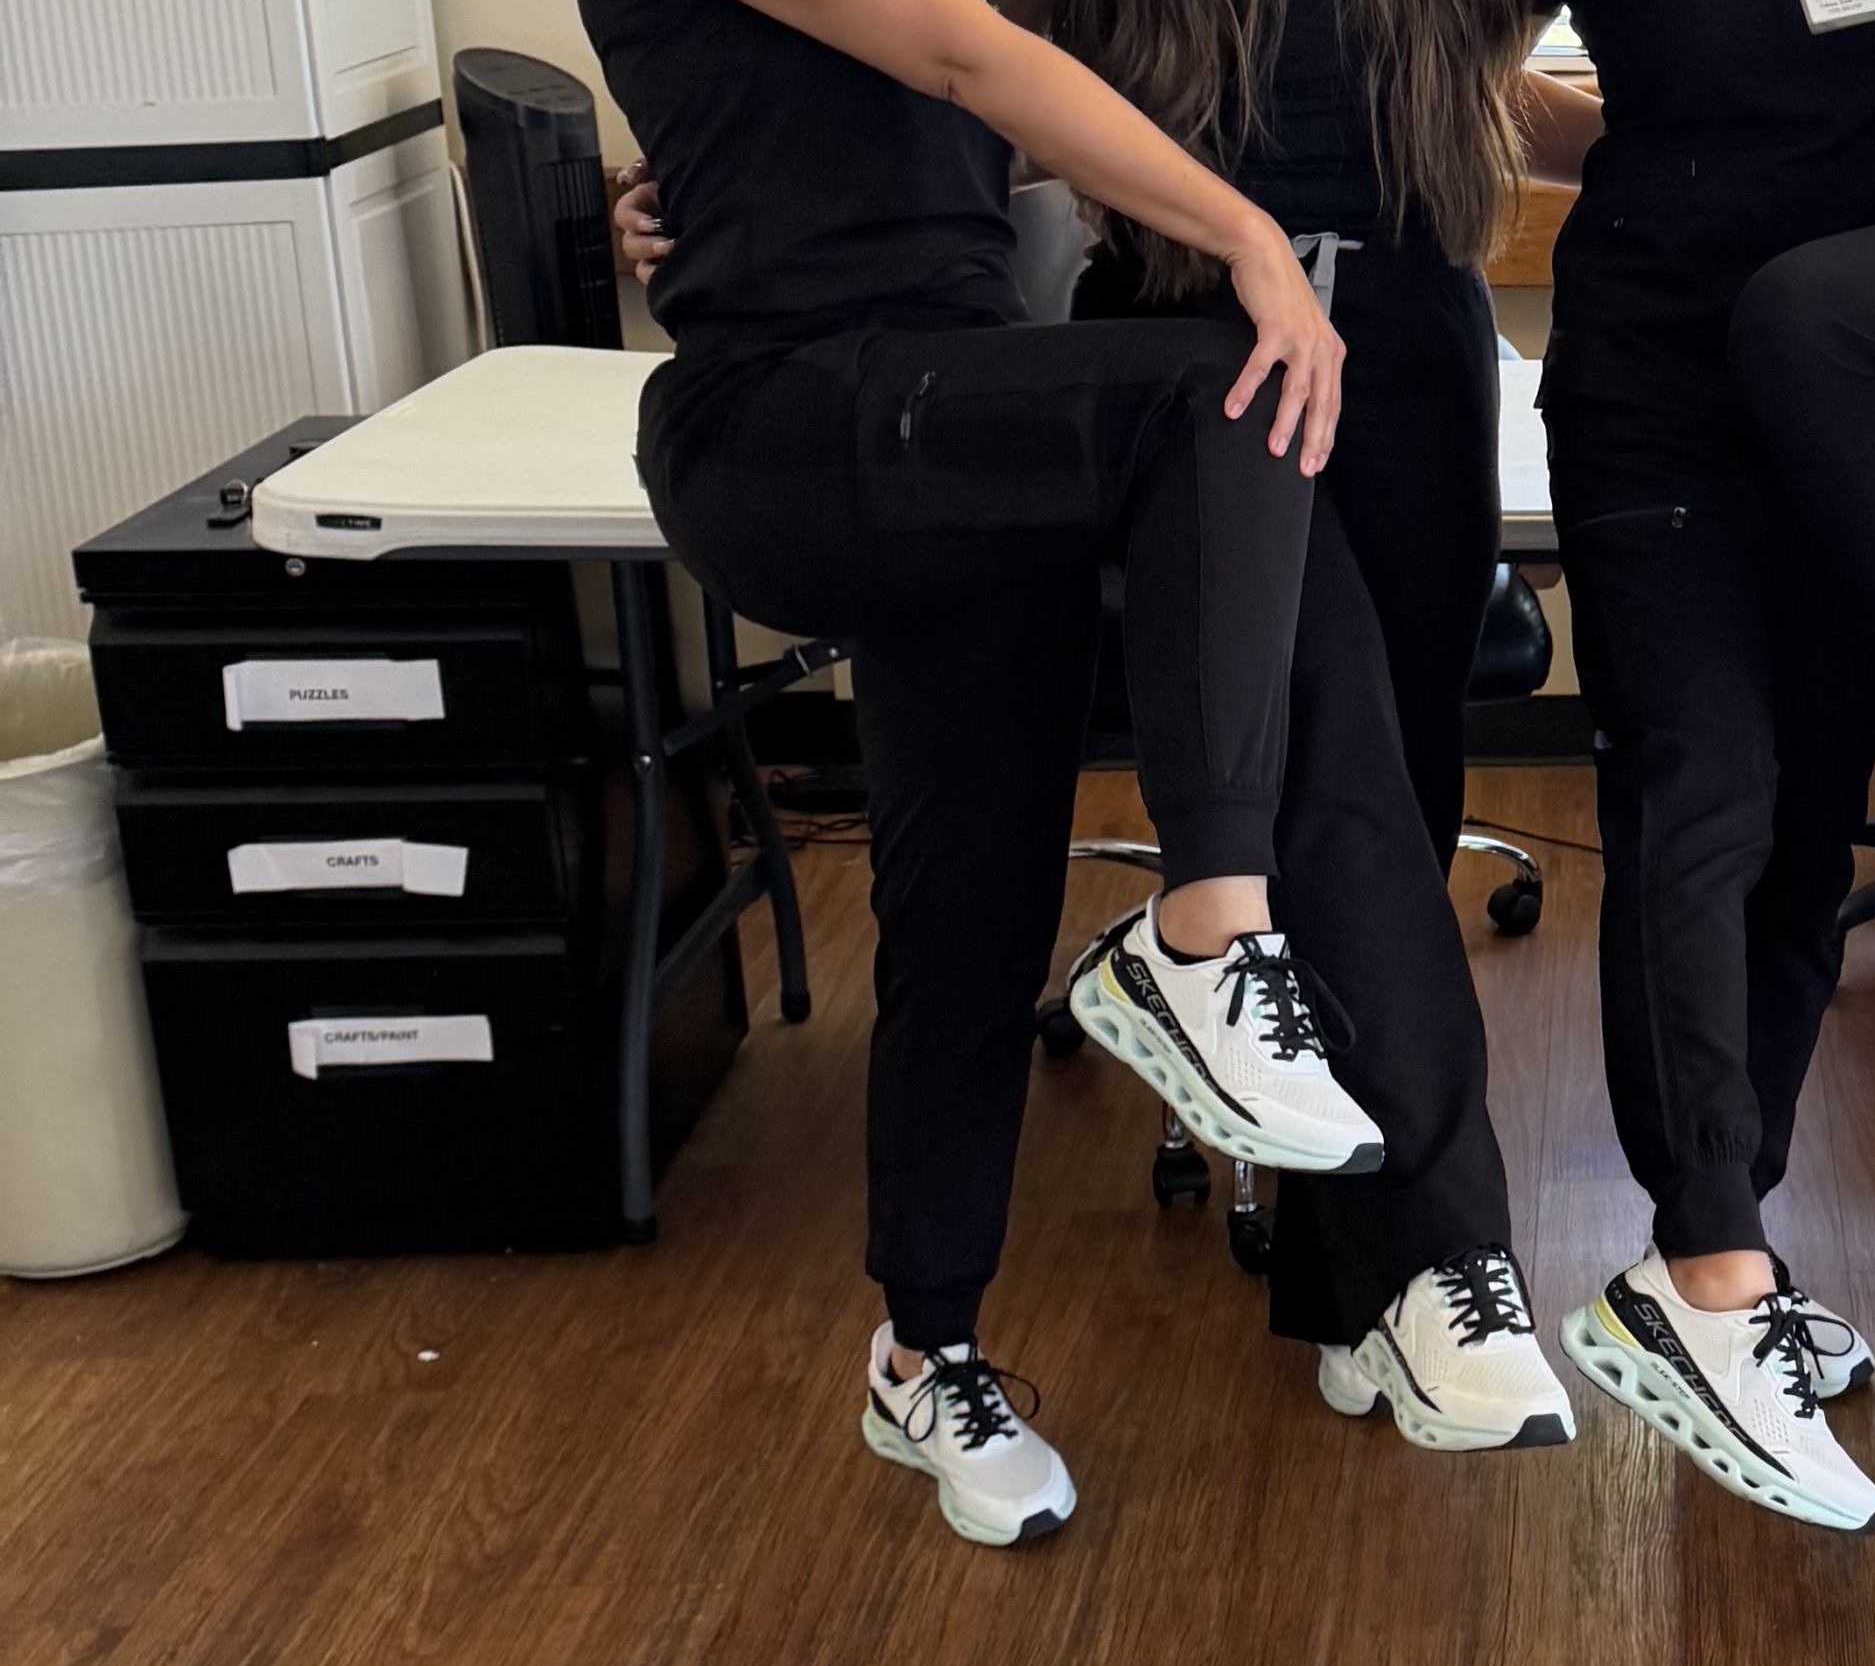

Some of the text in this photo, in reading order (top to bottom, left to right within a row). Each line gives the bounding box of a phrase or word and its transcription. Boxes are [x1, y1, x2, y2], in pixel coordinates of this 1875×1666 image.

[289, 688, 350, 702] PUZZLES
[326, 855, 379, 868] CRAFTS
[1125, 961, 1219, 1095] SKECHE
[323, 1028, 419, 1044] CRAFTS/PAINT
